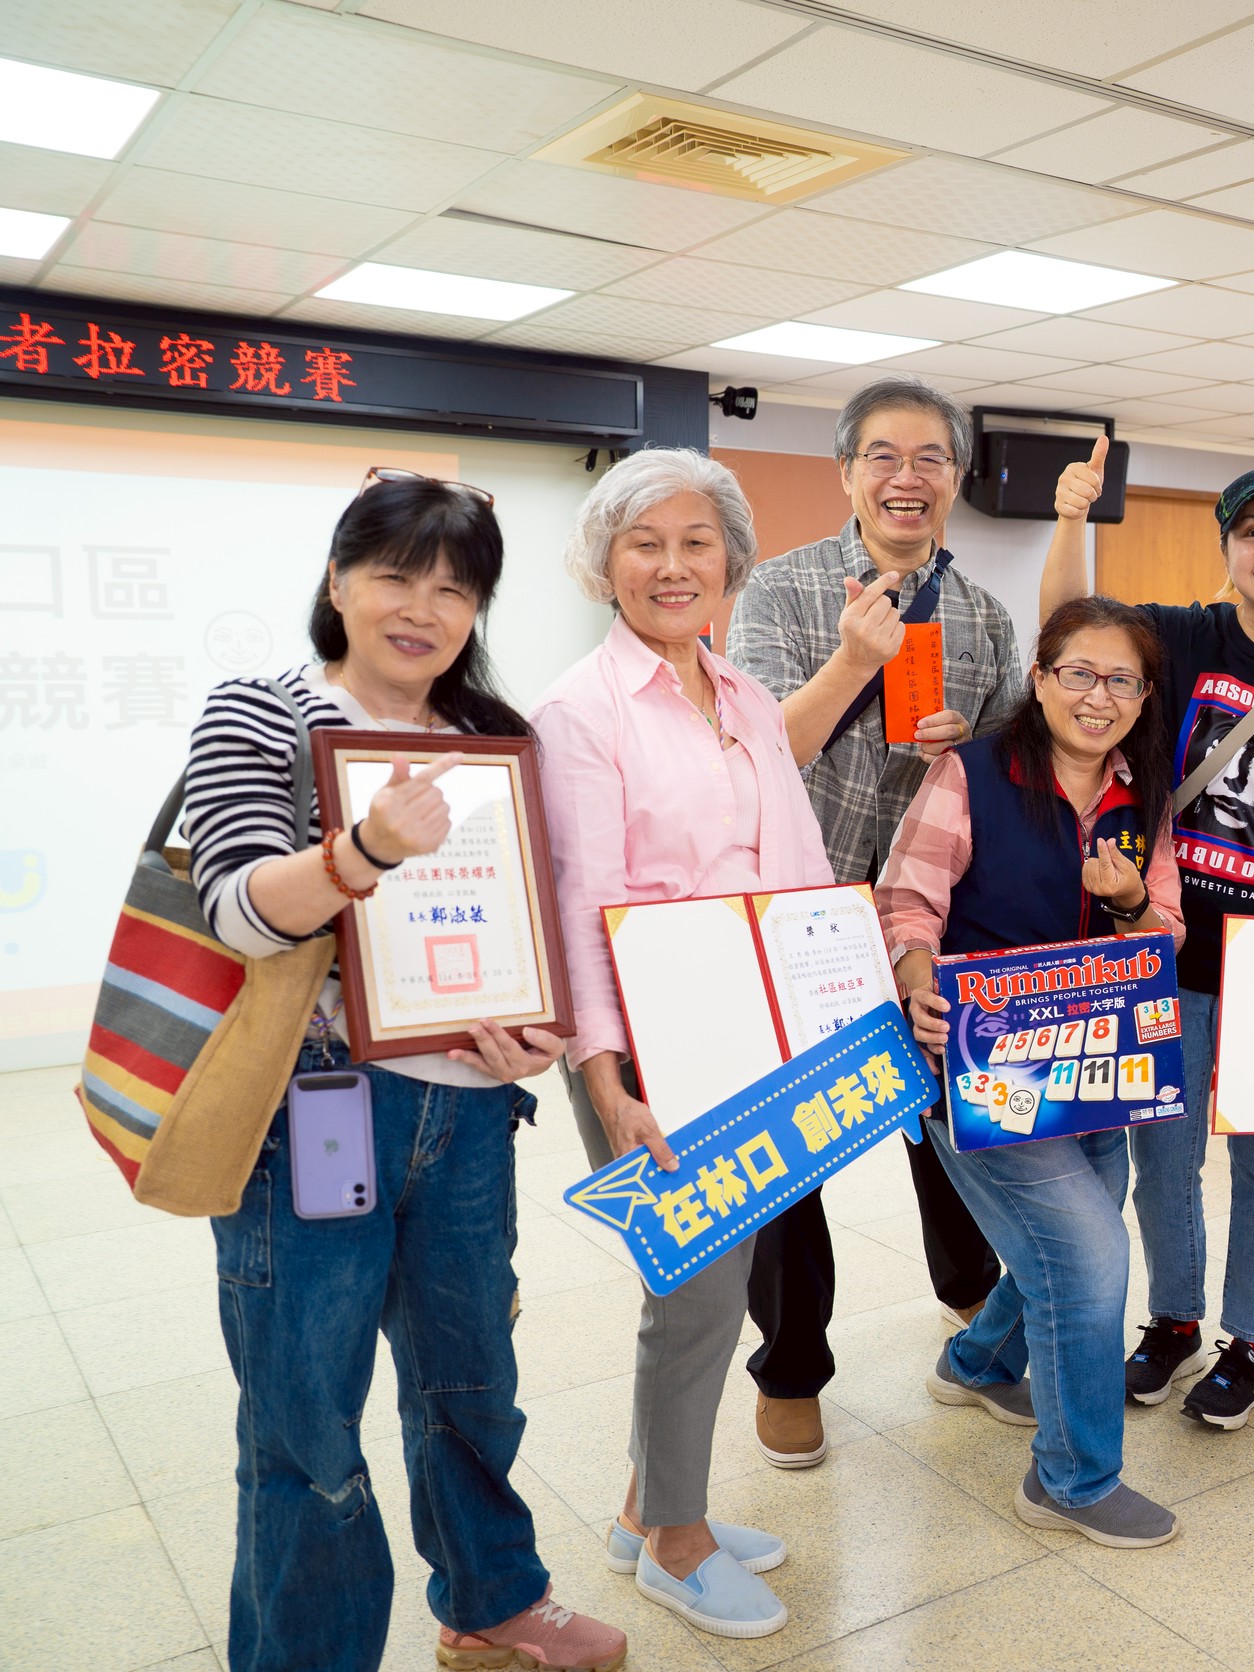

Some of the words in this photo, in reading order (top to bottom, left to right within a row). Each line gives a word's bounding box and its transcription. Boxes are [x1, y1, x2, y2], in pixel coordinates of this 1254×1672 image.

[0, 312, 357, 403] 者拉密競賽
[1184, 874, 1235, 897] SWEETIE
[956, 947, 1162, 1013] Rummikub
[1002, 964, 1028, 974] ORIGINAL
[1015, 995, 1050, 1007] BRINGS
[1053, 990, 1088, 1002] PEOPLE
[1089, 983, 1139, 996] TOGETHER
[1143, 1005, 1149, 1014] 3
[1161, 999, 1171, 1013] 3
[1028, 1006, 1065, 1022] XXL
[1067, 996, 1126, 1016] 拉密大字版
[995, 1034, 1007, 1052] 4
[1014, 1031, 1028, 1050] 5
[1036, 1027, 1051, 1047] 6
[1062, 1022, 1078, 1044] 7
[1092, 1017, 1110, 1040] 8
[1140, 1025, 1158, 1034] EXTRA
[1159, 1021, 1177, 1030] LARGE
[1141, 1026, 1178, 1040] NUMBERS
[1052, 1060, 1075, 1085] 11
[1083, 1059, 1110, 1085] 11
[1120, 1056, 1149, 1083] 11
[961, 1074, 972, 1090] 3
[974, 1074, 989, 1093] 3
[991, 1082, 1008, 1107] 3
[653, 1130, 789, 1249] 在林口
[791, 1050, 907, 1154] 創未來
